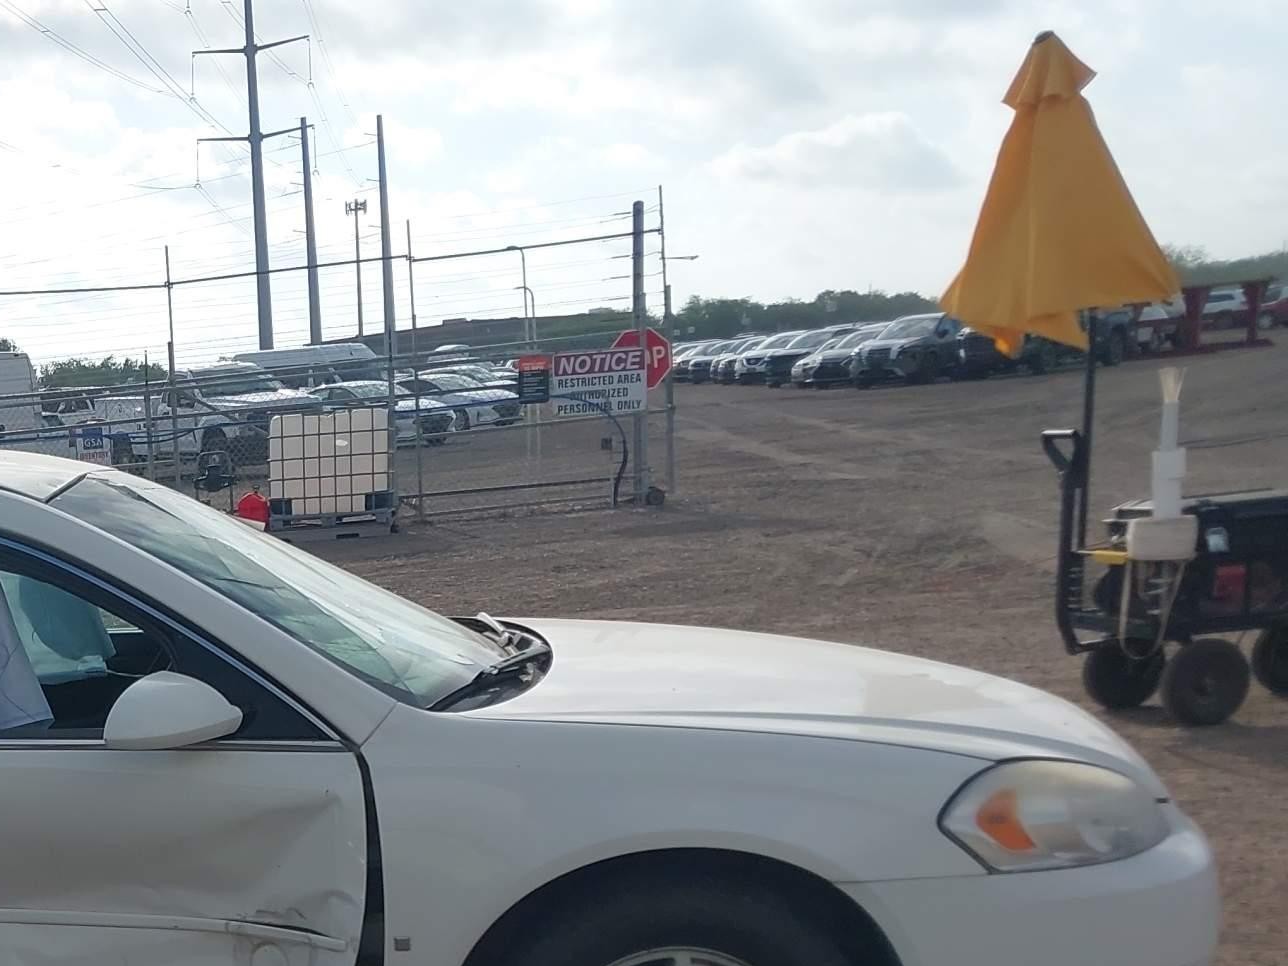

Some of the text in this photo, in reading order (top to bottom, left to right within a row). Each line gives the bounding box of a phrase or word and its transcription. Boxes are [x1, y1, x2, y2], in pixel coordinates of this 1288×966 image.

[558, 351, 642, 375] NOTICE
[557, 375, 614, 389] RESTRICTED
[617, 373, 642, 384] AREA
[557, 400, 642, 415] PERSONNEL ONLY
[84, 438, 103, 447] GSA
